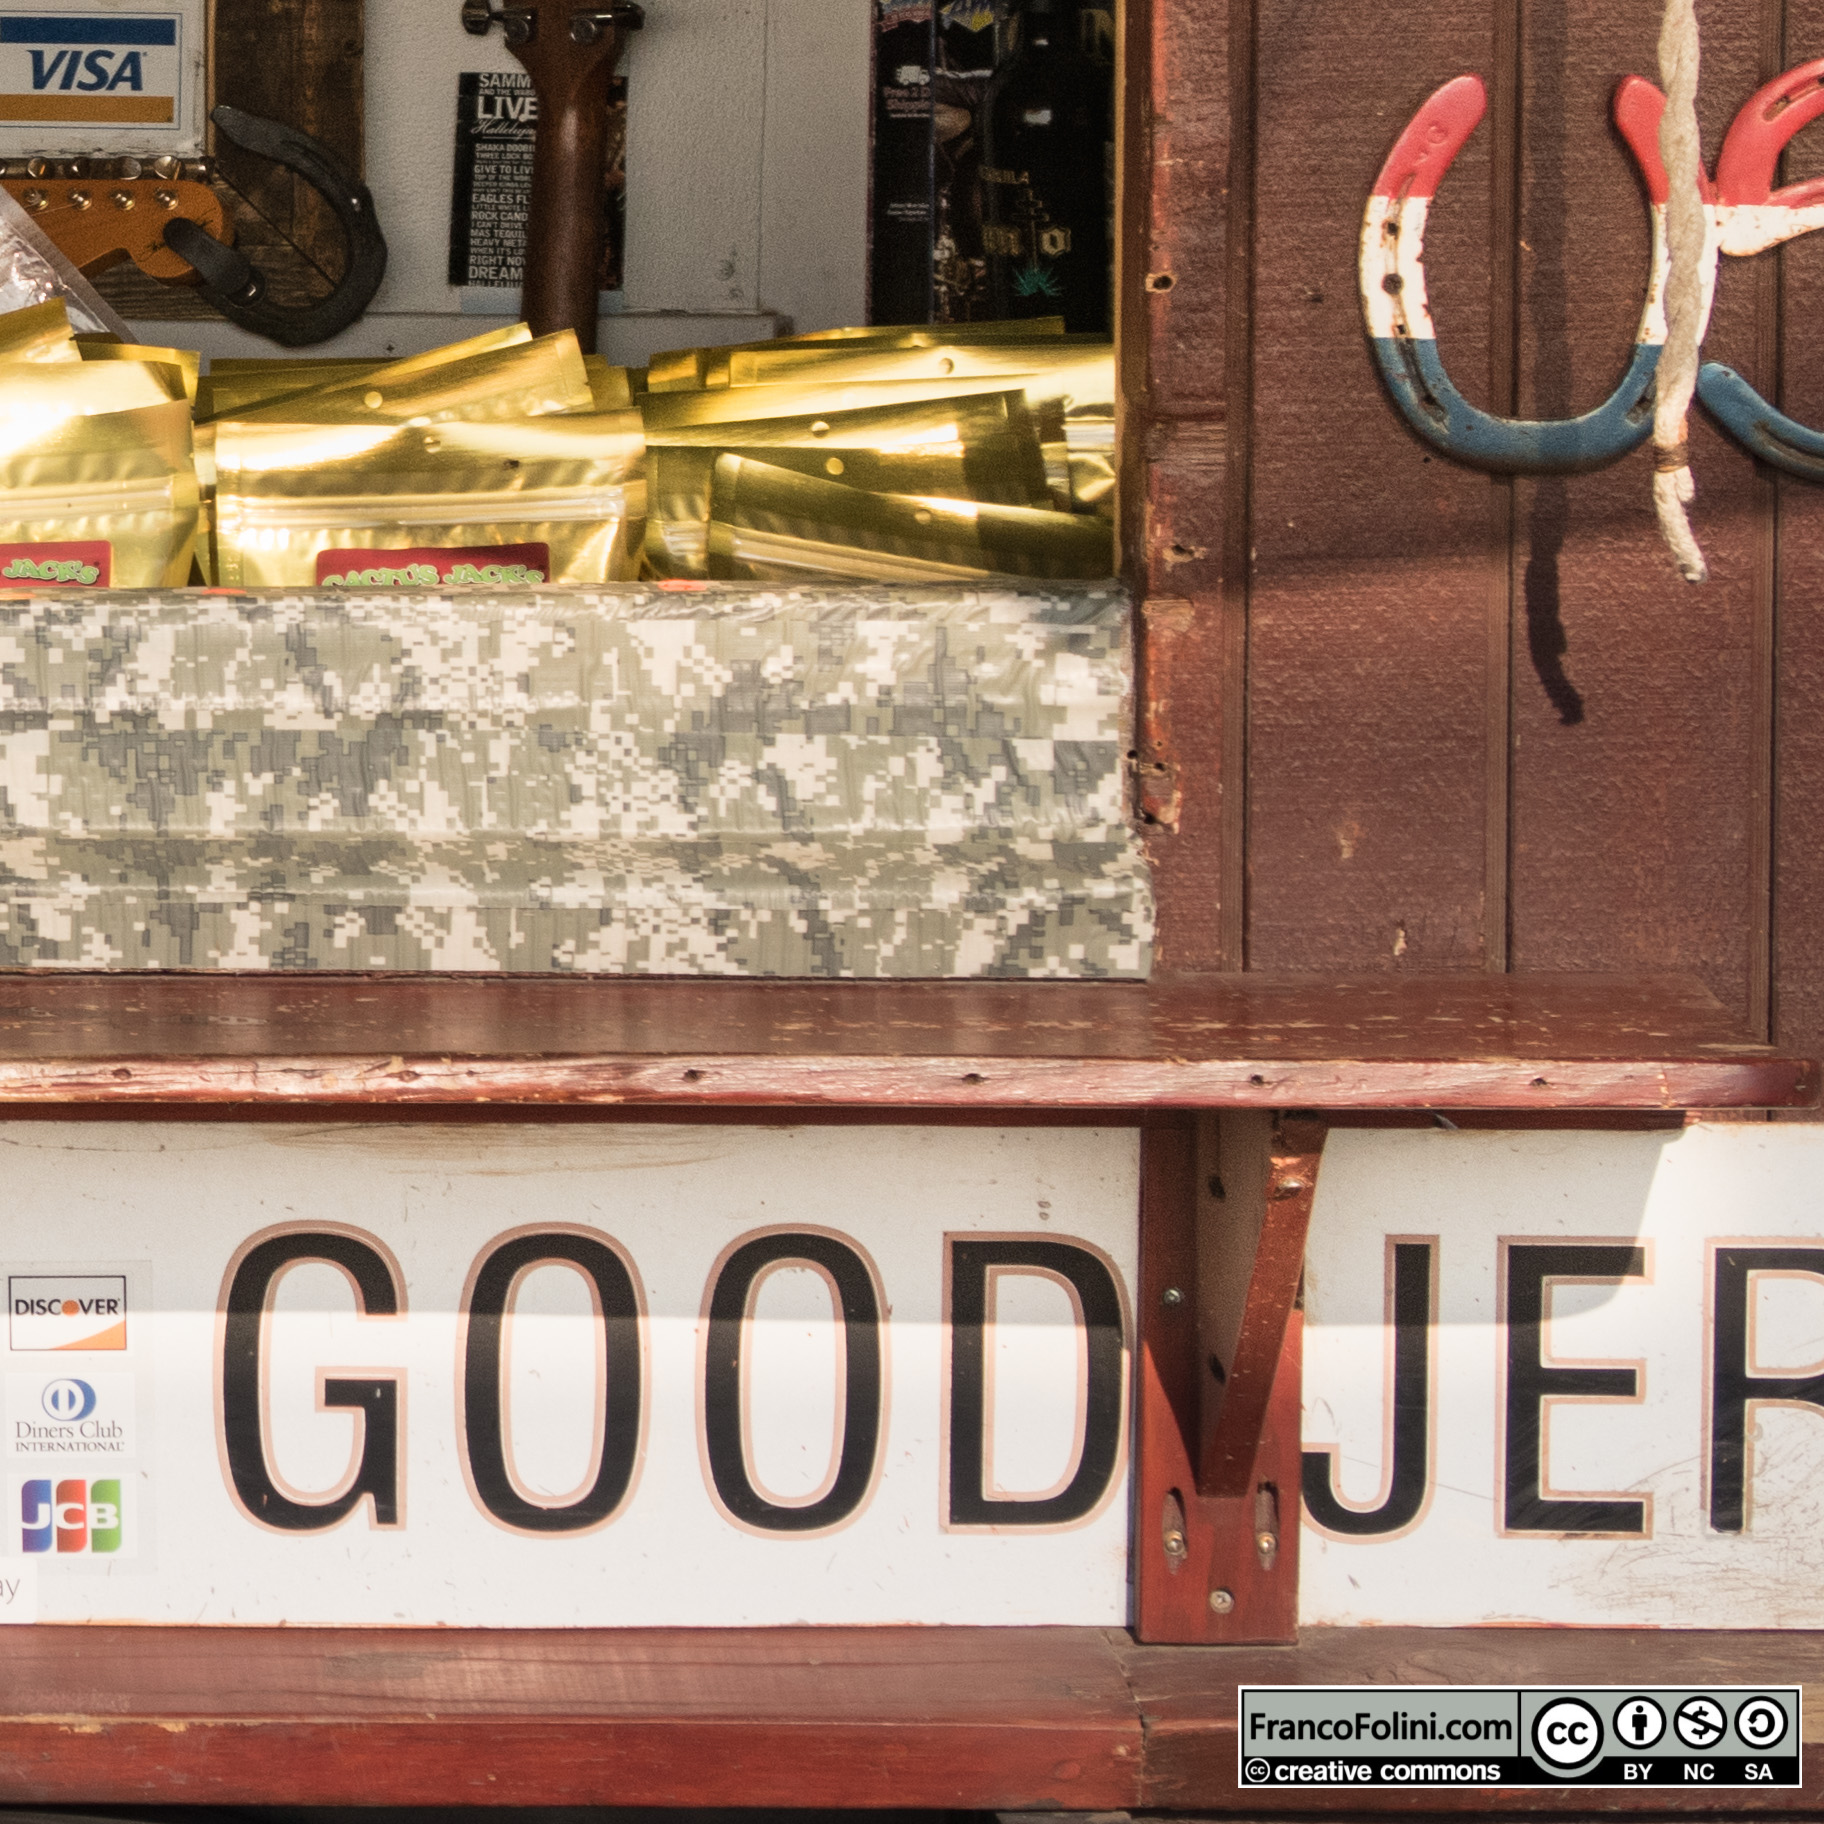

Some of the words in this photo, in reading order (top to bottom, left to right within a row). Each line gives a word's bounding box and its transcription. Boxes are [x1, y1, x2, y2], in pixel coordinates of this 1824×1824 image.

[26, 49, 144, 91] VISA
[478, 73, 532, 88] SAMM
[473, 164, 497, 174] GIVE
[499, 164, 512, 174] TO
[472, 193, 513, 204] EAGLES
[515, 194, 531, 205] FL
[471, 211, 498, 221] ROCK
[499, 211, 529, 222] CAND
[470, 229, 491, 237] MAS
[469, 255, 503, 265] RIGHT
[2, 559, 99, 585] JACK'S
[14, 1298, 120, 1316] DISCOVER
[214, 1220, 1136, 1545] GOOD
[15, 1420, 75, 1439] Diners
[79, 1420, 123, 1439] Club
[14, 1440, 125, 1453] INTERNATIONAL
[21, 1502, 120, 1530] JCB
